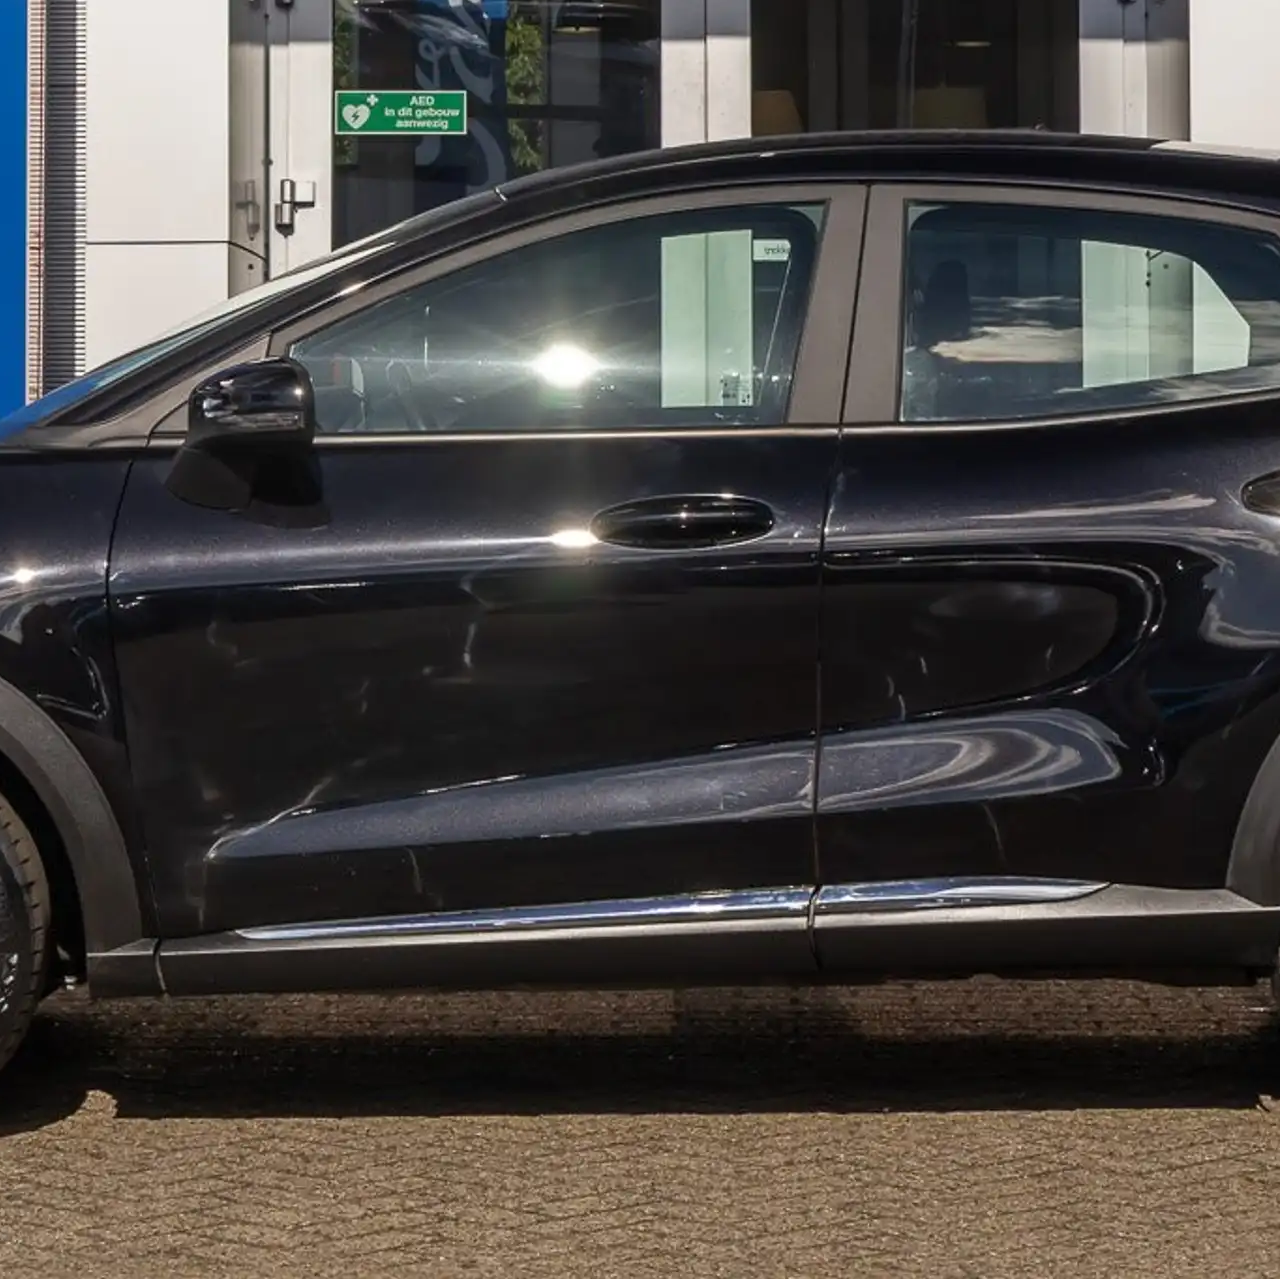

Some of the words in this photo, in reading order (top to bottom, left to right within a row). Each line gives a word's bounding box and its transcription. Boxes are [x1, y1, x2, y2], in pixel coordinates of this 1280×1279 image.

[409, 95, 435, 107] AED
[397, 106, 413, 117] dit
[415, 107, 460, 119] gebouw
[395, 118, 449, 130] aanwezig
